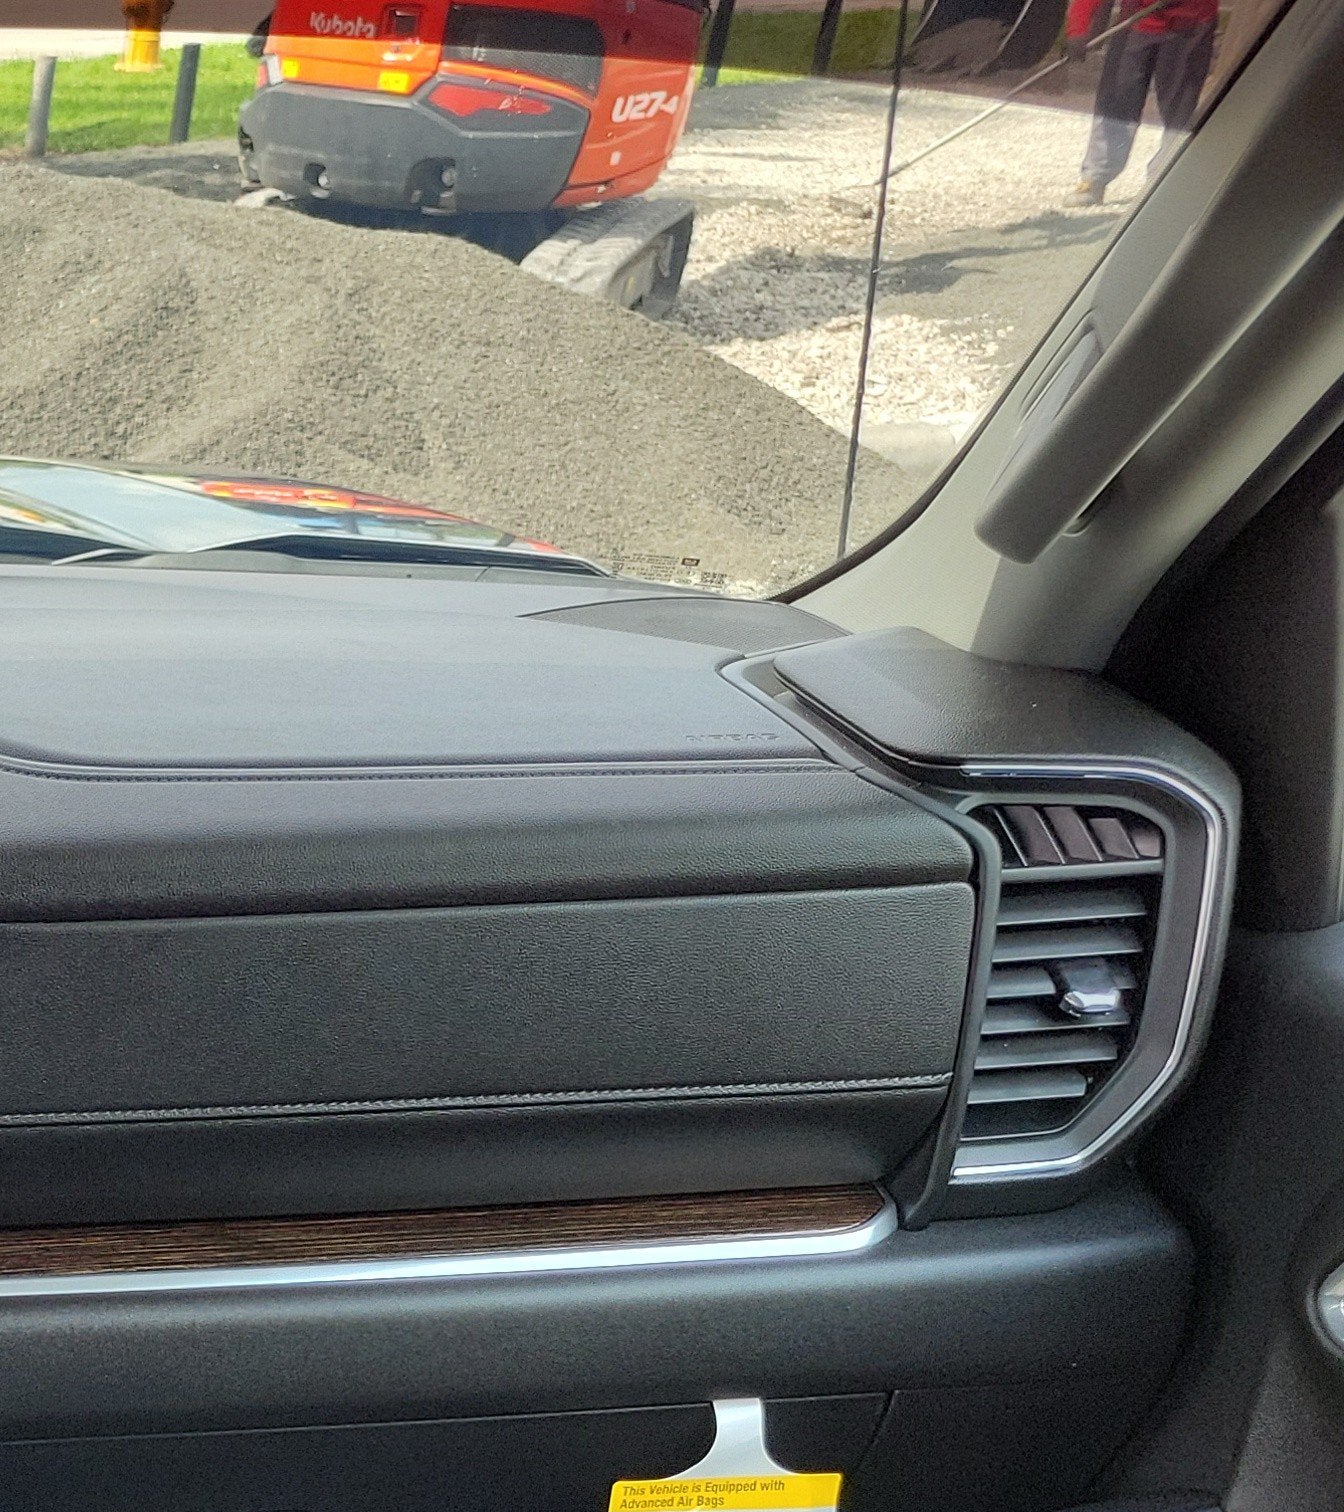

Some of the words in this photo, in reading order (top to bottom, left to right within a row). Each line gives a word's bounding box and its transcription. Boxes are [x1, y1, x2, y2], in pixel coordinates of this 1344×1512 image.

[309, 11, 377, 39] Kubota
[622, 1486, 646, 1497] This
[649, 1483, 689, 1495] Vehicle
[692, 1482, 702, 1493] is
[705, 1480, 757, 1494] Equipped
[760, 1479, 785, 1491] with
[619, 1496, 675, 1510] Advanced
[677, 1496, 693, 1507] Air
[696, 1495, 725, 1509] Bags
